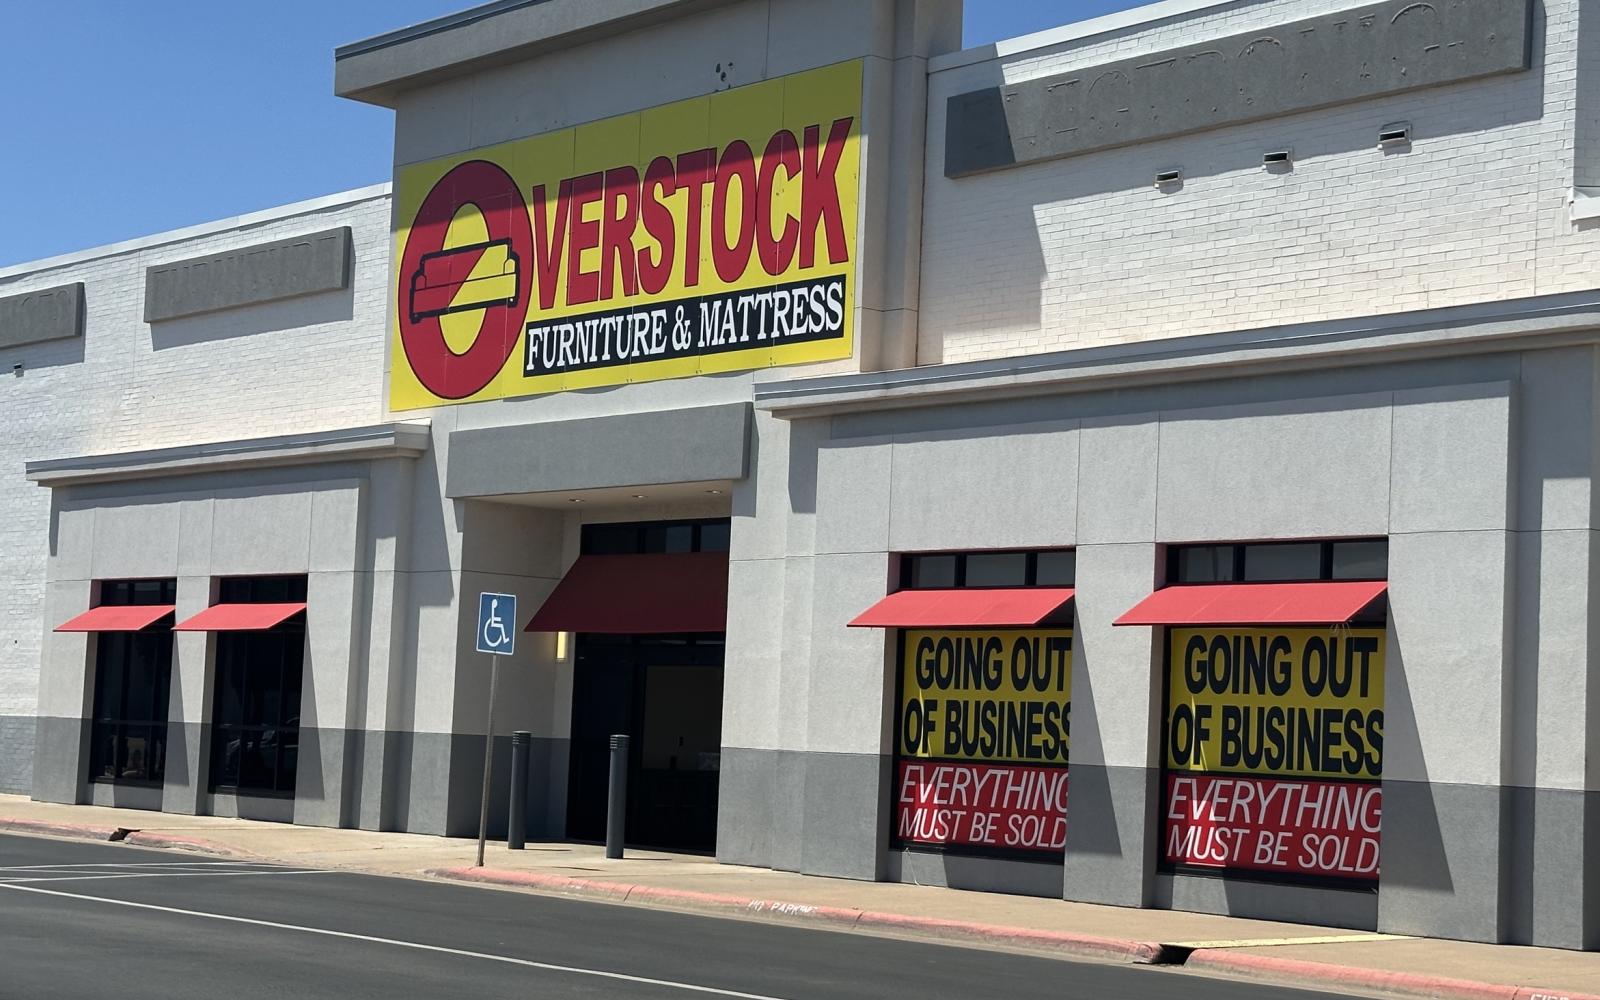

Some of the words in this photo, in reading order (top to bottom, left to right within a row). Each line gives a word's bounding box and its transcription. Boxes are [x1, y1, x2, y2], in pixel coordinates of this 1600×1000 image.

[398, 117, 854, 399] OVERSTOCK
[526, 311, 667, 370] FURNITURE
[672, 306, 691, 349] &
[698, 282, 844, 348] MATTRESS
[915, 636, 1003, 692] GOING
[1011, 637, 1072, 692] OUT
[1184, 635, 1292, 696] GOING
[1301, 636, 1378, 698] OUT
[904, 698, 937, 755] OF
[1170, 703, 1212, 766] OF
[1220, 705, 1384, 776] BUSINESS
[898, 807, 966, 840] MUST
[969, 812, 1000, 843] BE
[1004, 814, 1068, 848] SOLD
[1168, 778, 1382, 833] EVERYTHING
[1167, 825, 1250, 861] MUST
[1253, 831, 1292, 866] BE
